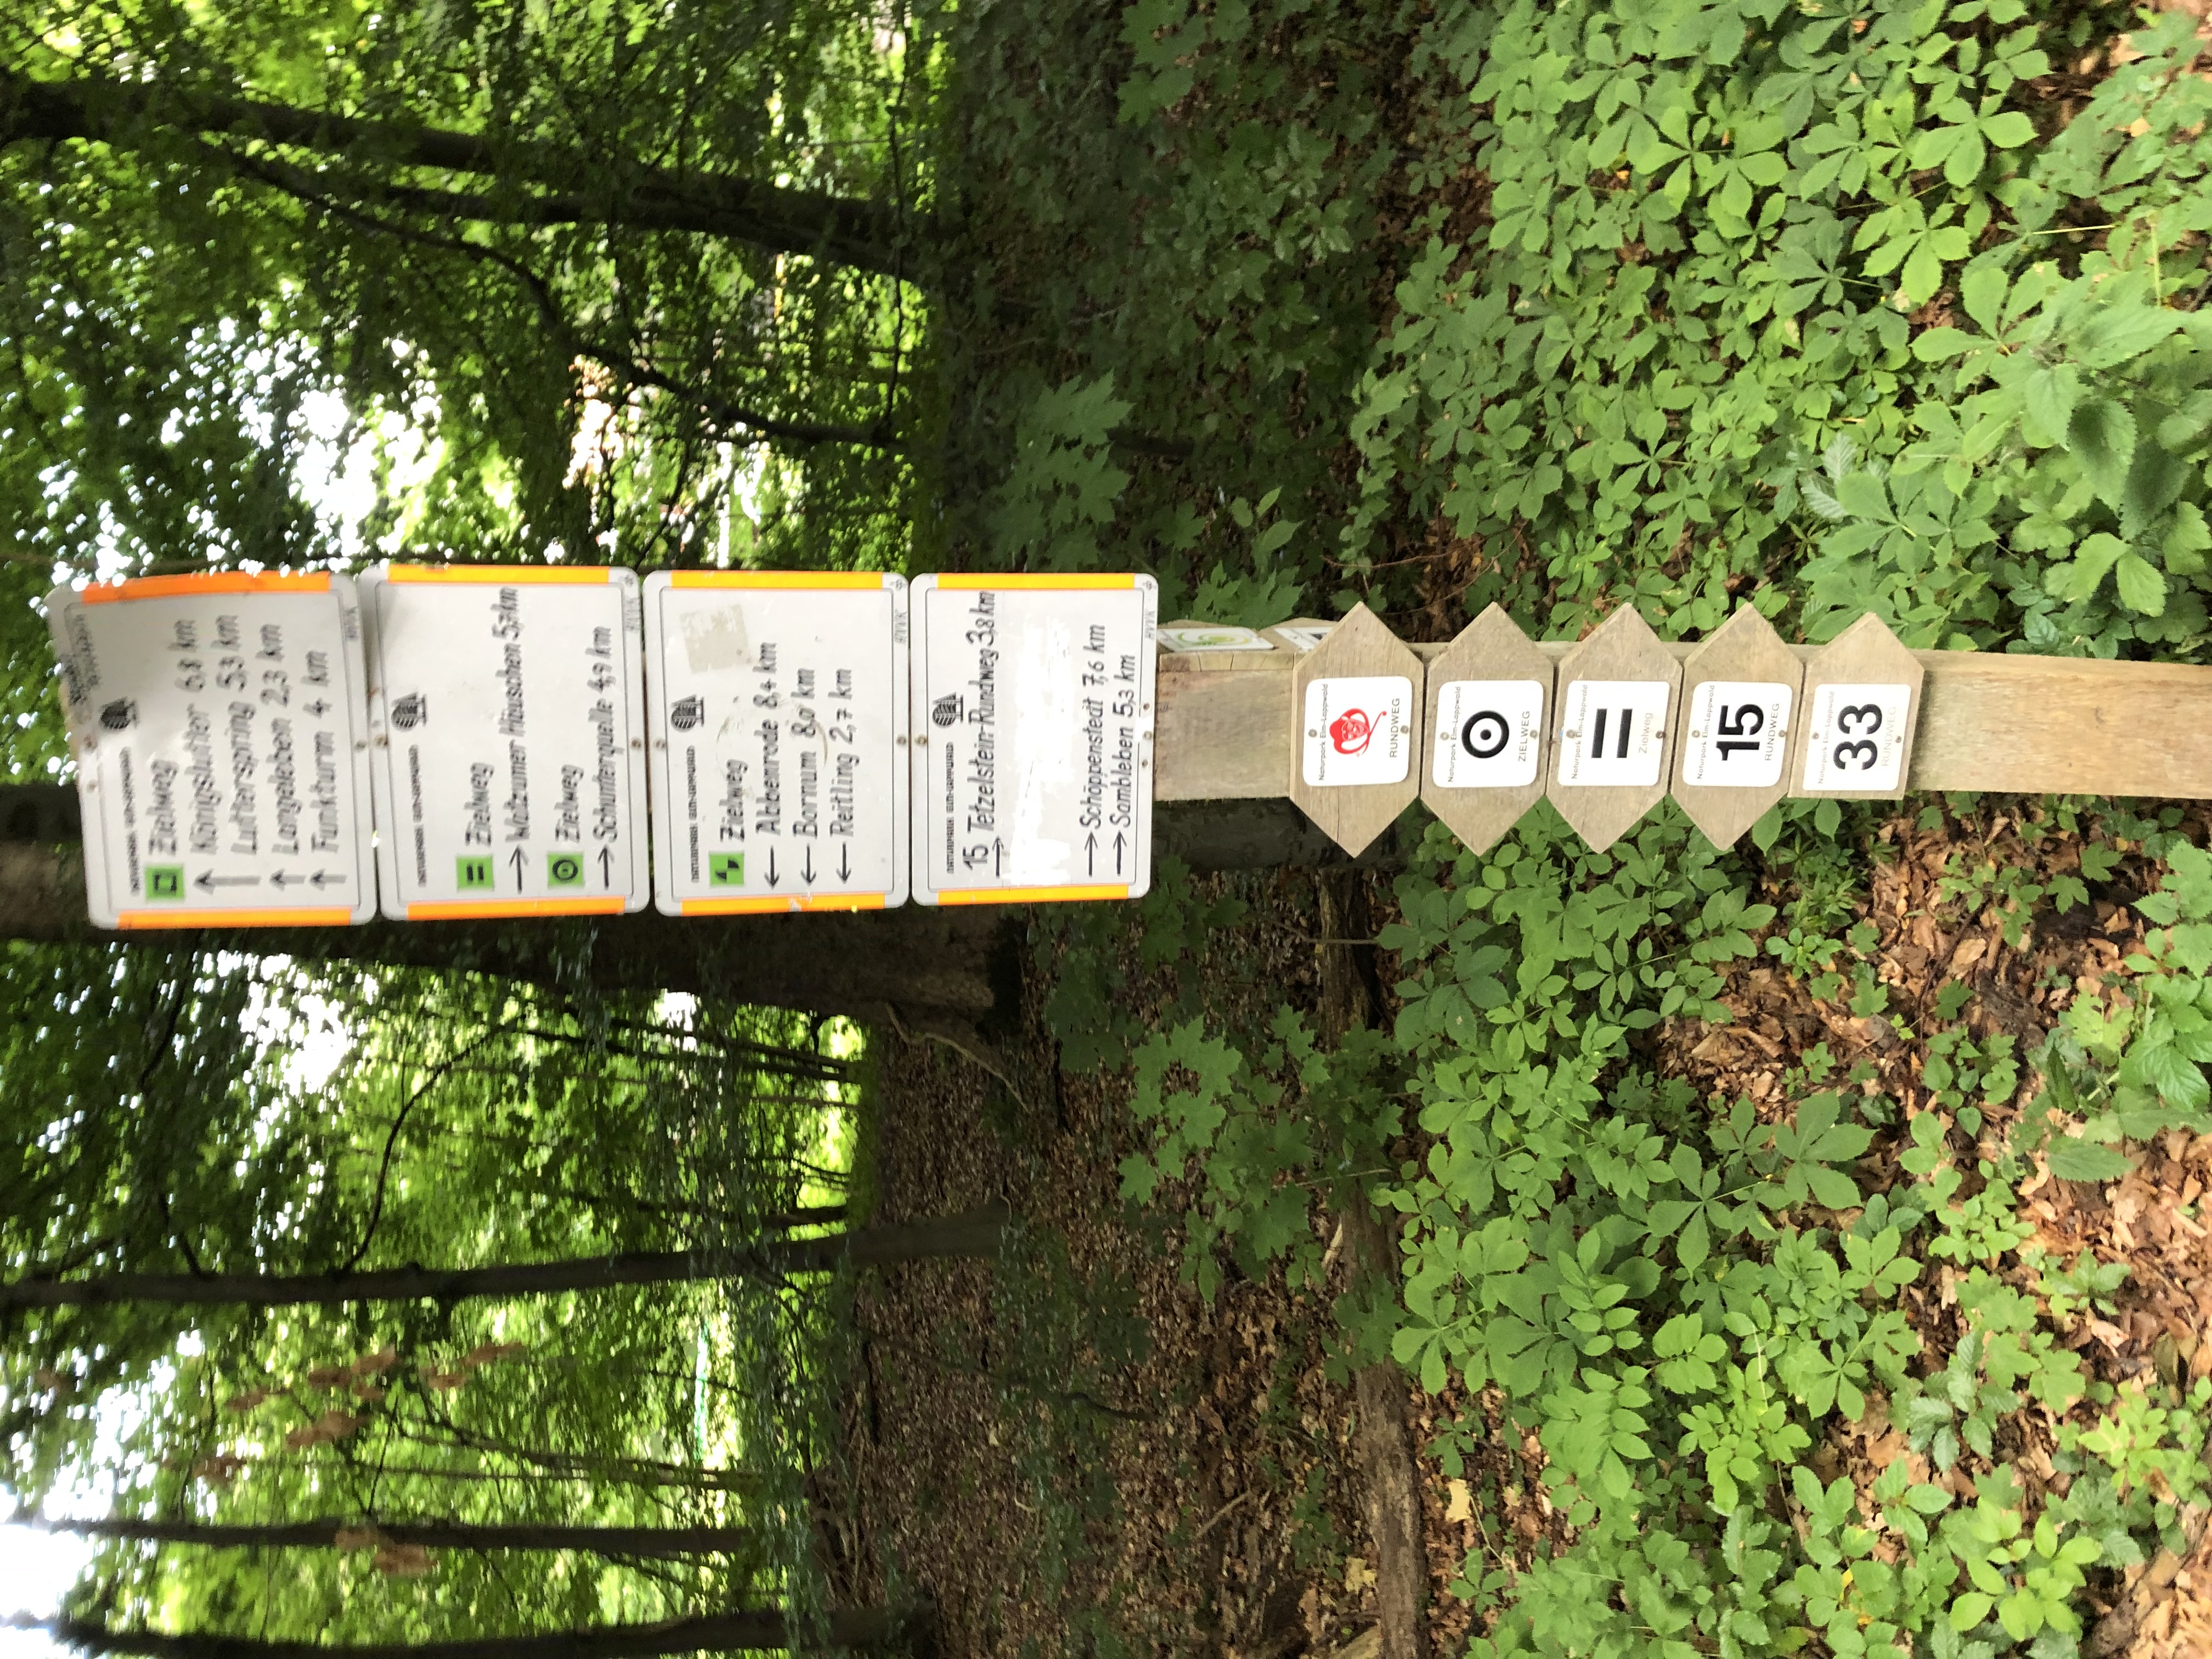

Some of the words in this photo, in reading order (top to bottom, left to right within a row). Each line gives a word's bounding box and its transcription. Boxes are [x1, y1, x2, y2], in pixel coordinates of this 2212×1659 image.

[968, 591, 995, 616] km
[167, 620, 199, 652] km
[210, 616, 241, 651] km
[254, 624, 285, 662] km
[584, 627, 612, 659] km
[965, 617, 998, 646] 3,8
[1082, 624, 1105, 654] km
[300, 651, 330, 687] km
[587, 662, 617, 694] 4,9
[752, 642, 777, 674] km
[790, 668, 815, 699] km
[1082, 660, 1109, 687] 7,6
[1113, 654, 1135, 683] km
[259, 670, 293, 707] 2,3
[302, 698, 332, 718] 4
[495, 643, 525, 737] Häuschen
[753, 678, 781, 710] 8,4
[828, 669, 852, 700] km
[1112, 689, 1136, 718] 5,3
[1576, 684, 1588, 737] Elm-Lappwald
[828, 708, 856, 746] 2,7
[1320, 684, 1328, 738] Elm-Lappwald
[1390, 698, 1400, 758] RUNDWEG
[1451, 686, 1461, 740] Elm-Lappwald
[1518, 710, 1530, 762] ZIELWEG
[1638, 713, 1654, 754] Zielweg
[1697, 741, 1707, 779] Naturpark
[1702, 685, 1715, 738] Elm-Lappwald
[1716, 703, 1764, 761] 15
[1764, 703, 1780, 761] RUNDWEG
[1822, 691, 1835, 743] Elm-Lappwald
[1833, 704, 1882, 770] 33
[1881, 706, 1897, 766] RUNDWEG
[967, 648, 998, 833] Tetzelstein-Rundweg
[1079, 696, 1108, 829] Schöppenstedt
[1318, 741, 1327, 781] Naturpark
[1448, 743, 1457, 782] Naturpark
[1571, 741, 1582, 779] Naturpark
[1818, 746, 1829, 784] Naturpark
[183, 704, 222, 855] Königslutter
[224, 702, 259, 855] Lutterspring
[265, 718, 302, 855] Langeleben
[308, 731, 338, 853] Funkturm
[503, 740, 531, 843] Watzumer
[588, 698, 624, 843] Schunterquelle
[753, 719, 781, 836] Abbenrode
[792, 751, 817, 839] Bornum
[830, 753, 860, 838] Reitling
[1109, 726, 1133, 828] Sambleben
[145, 759, 179, 856] Zielweg
[463, 762, 495, 847] Zielweg
[554, 764, 584, 842] Zielweg
[719, 759, 748, 842] Zielweg
[962, 843, 988, 870] 15
